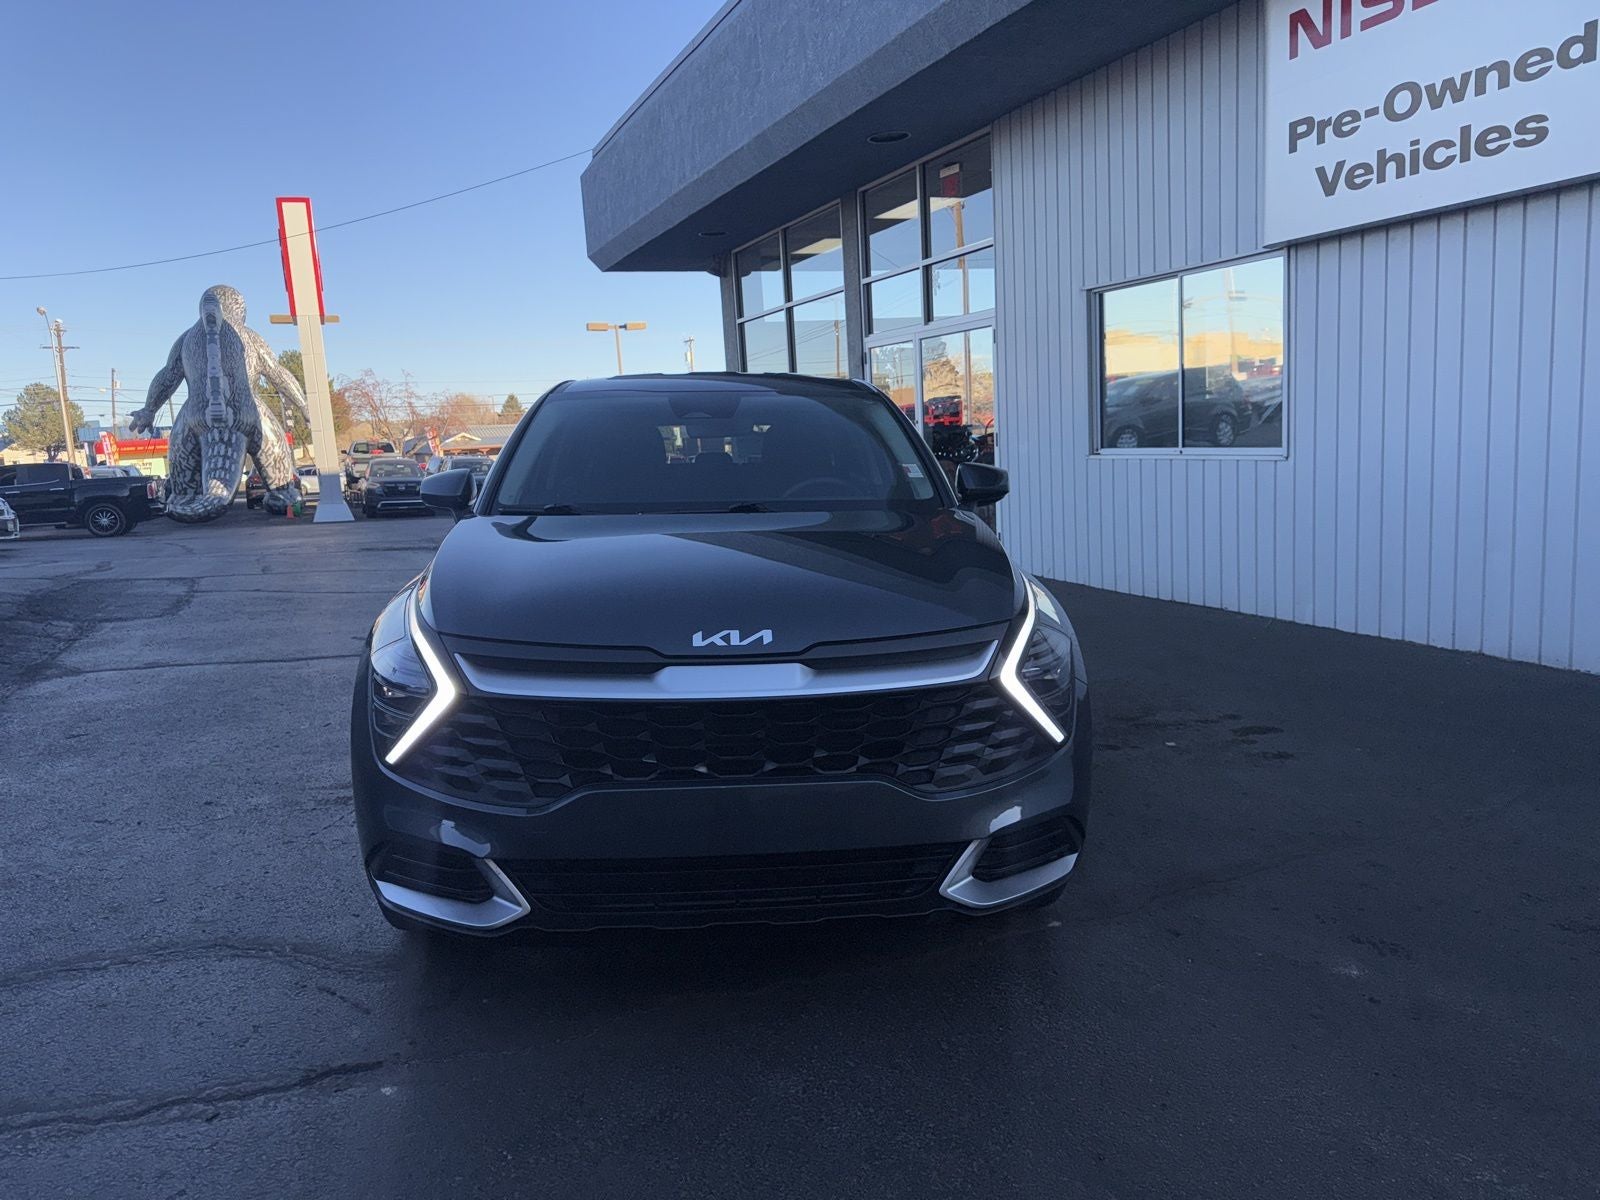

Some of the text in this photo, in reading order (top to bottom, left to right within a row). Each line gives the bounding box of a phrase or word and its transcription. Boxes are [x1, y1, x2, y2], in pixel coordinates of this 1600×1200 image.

[1288, 19, 1599, 154] Pre-Owned
[1315, 114, 1549, 197] Vehicles
[692, 629, 773, 647] KIA
